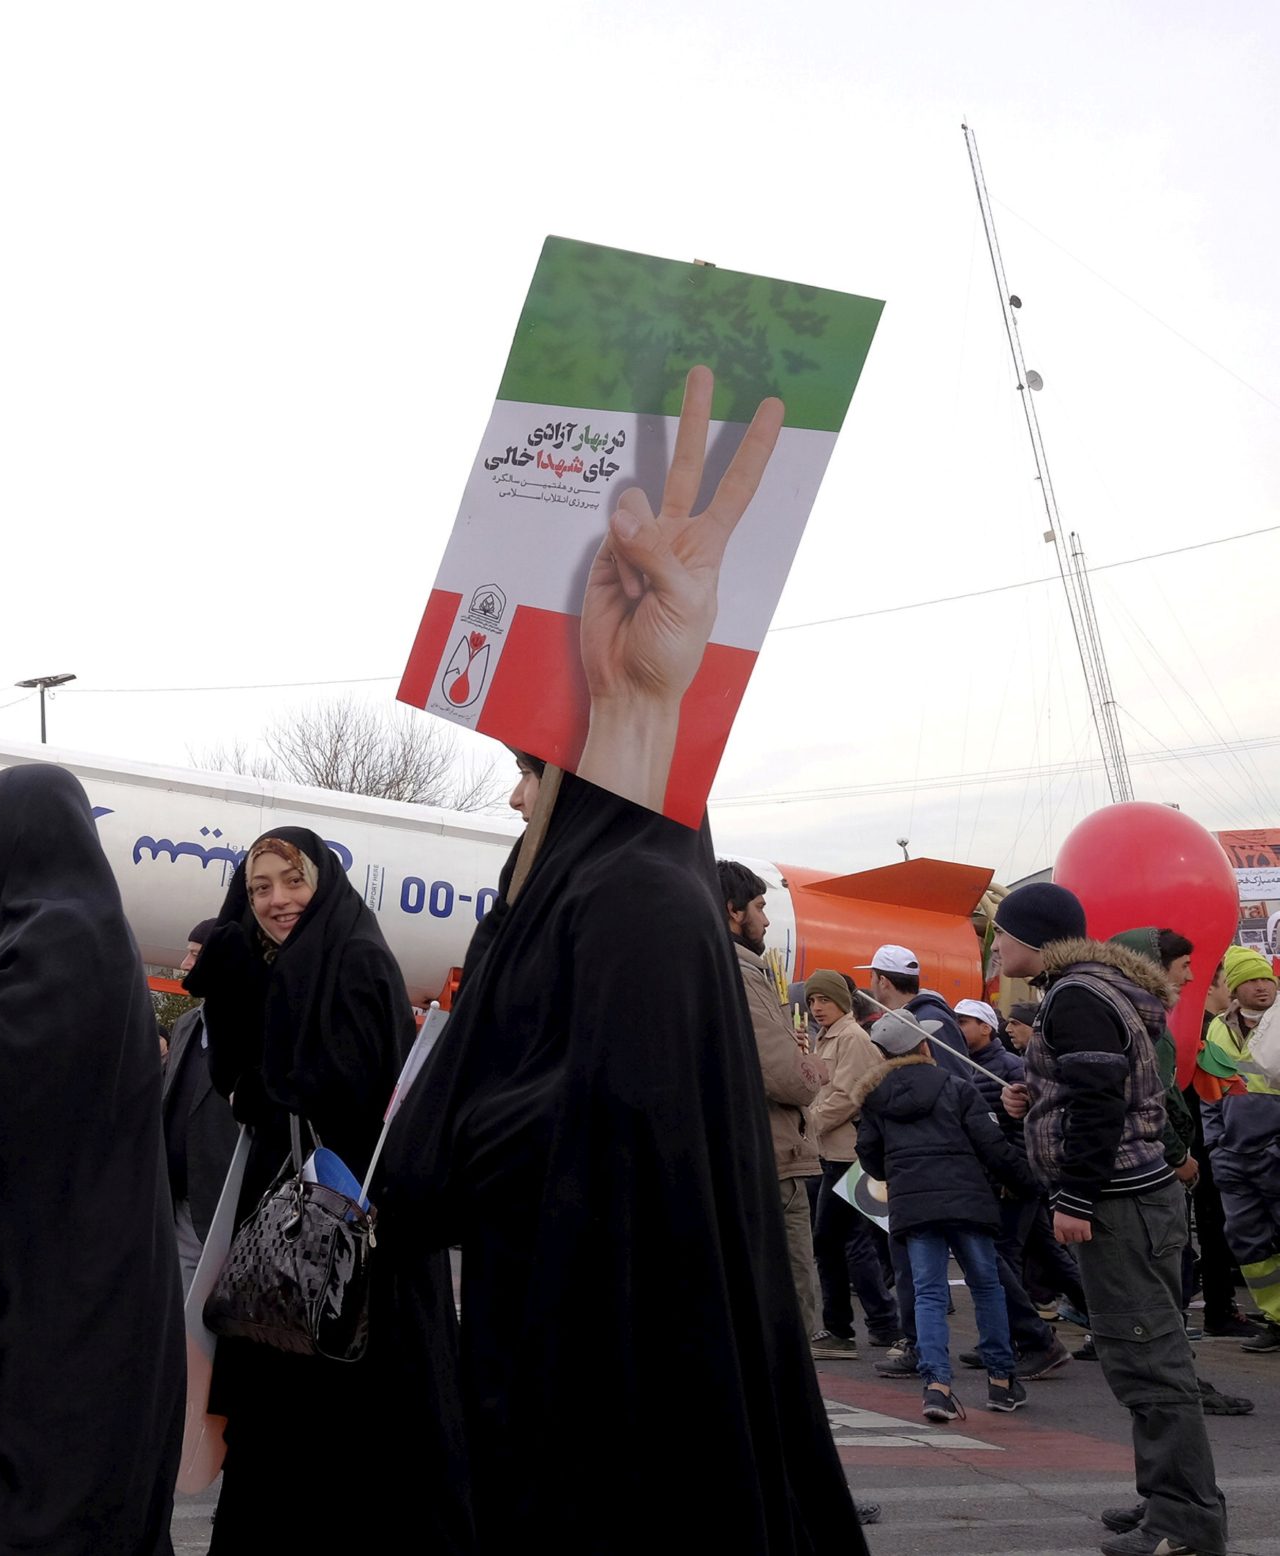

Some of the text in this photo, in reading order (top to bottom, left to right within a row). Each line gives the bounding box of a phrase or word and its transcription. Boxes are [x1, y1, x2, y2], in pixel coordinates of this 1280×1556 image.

[527, 421, 626, 455] در بهار آزادی
[484, 445, 620, 483] جای شهدا خالی
[498, 487, 600, 510] پیروزی انقلاب اسلامی
[520, 478, 567, 491] هفتمین
